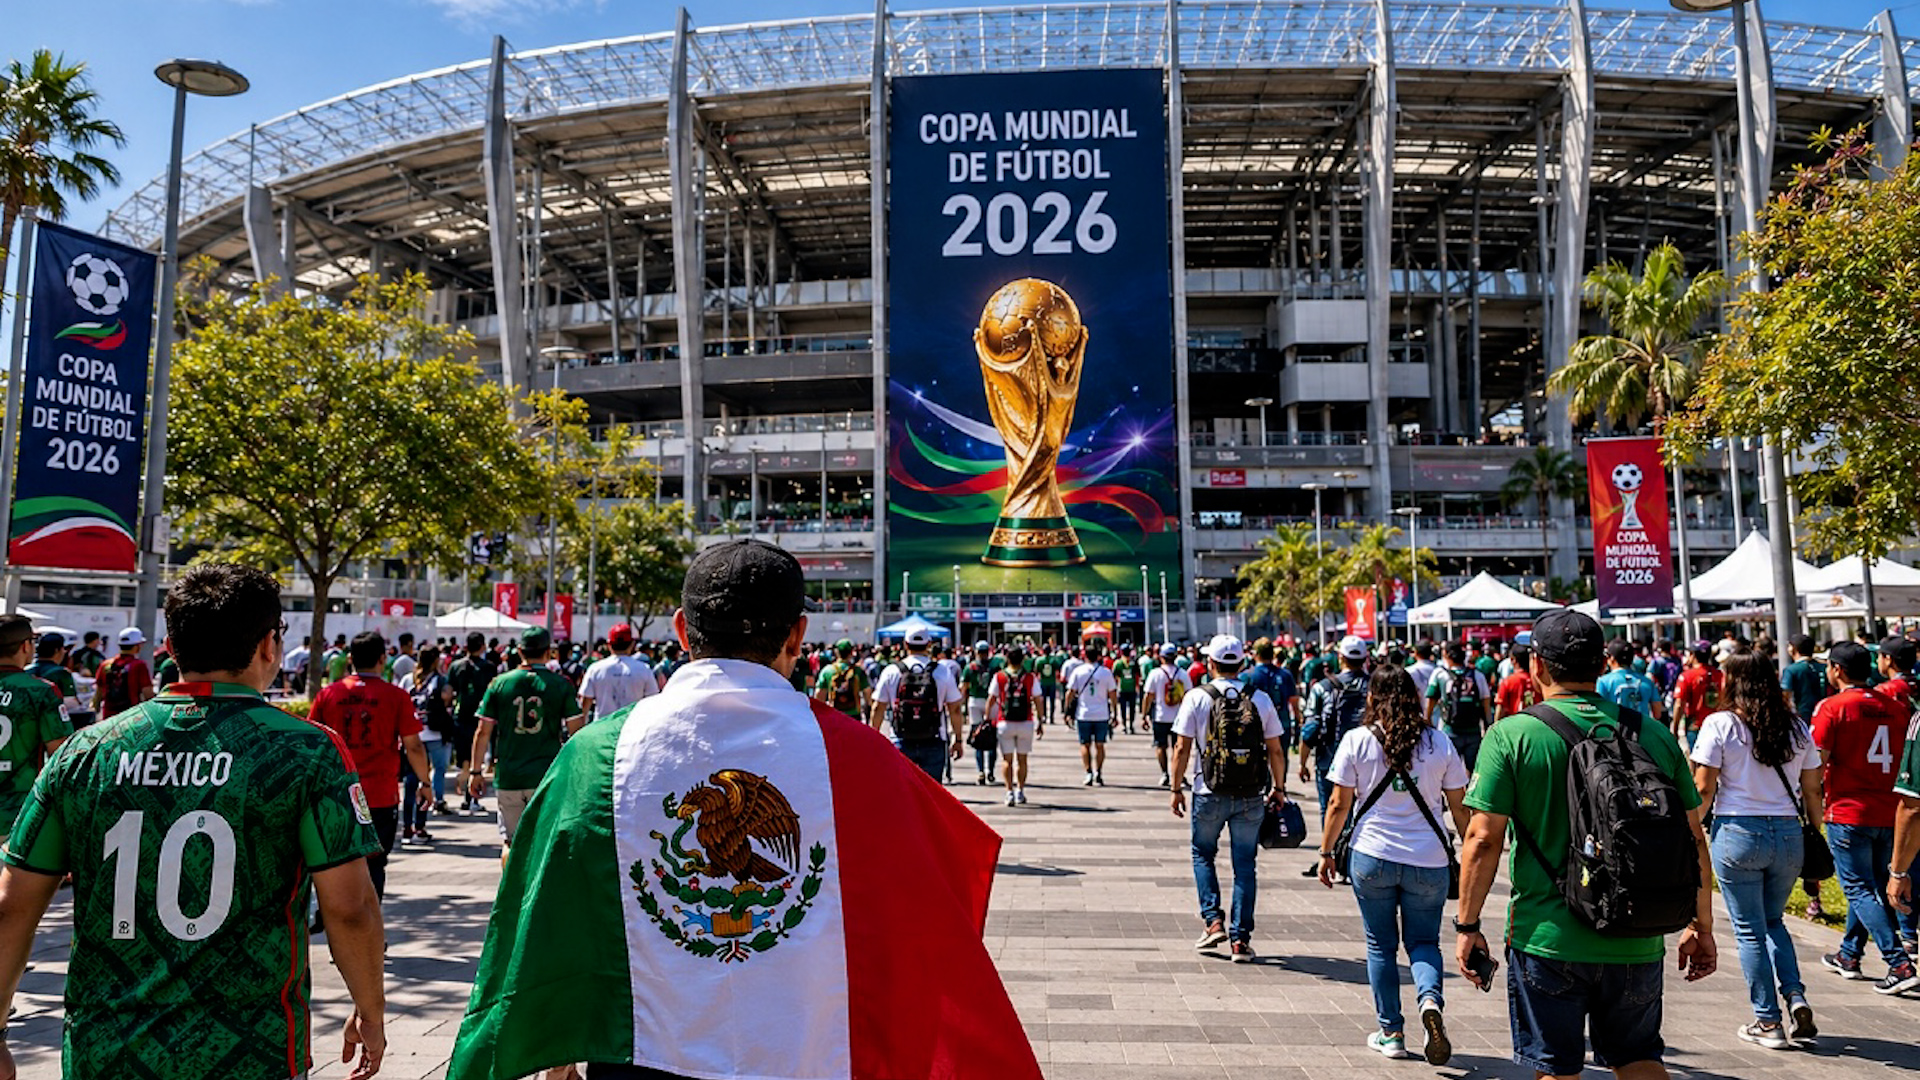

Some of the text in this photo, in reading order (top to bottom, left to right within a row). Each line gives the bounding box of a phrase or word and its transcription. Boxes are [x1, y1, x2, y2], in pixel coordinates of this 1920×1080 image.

[921, 109, 1136, 143] COPA MUNDIAL
[950, 143, 1109, 182] DE FÚTBOL
[943, 192, 1116, 256] 2026
[59, 354, 117, 385] COPA
[37, 378, 135, 414] MUNDIAL
[33, 407, 135, 441] DE FÚTBOL
[47, 437, 119, 475] 2026
[1605, 544, 1660, 556] MUNDIAL
[1616, 531, 1649, 543] COPA
[1605, 557, 1620, 568] DE
[1615, 569, 1655, 584] 2026
[116, 744, 232, 785] MÉXICO
[1867, 726, 1892, 772] 4
[104, 810, 236, 940] 10
